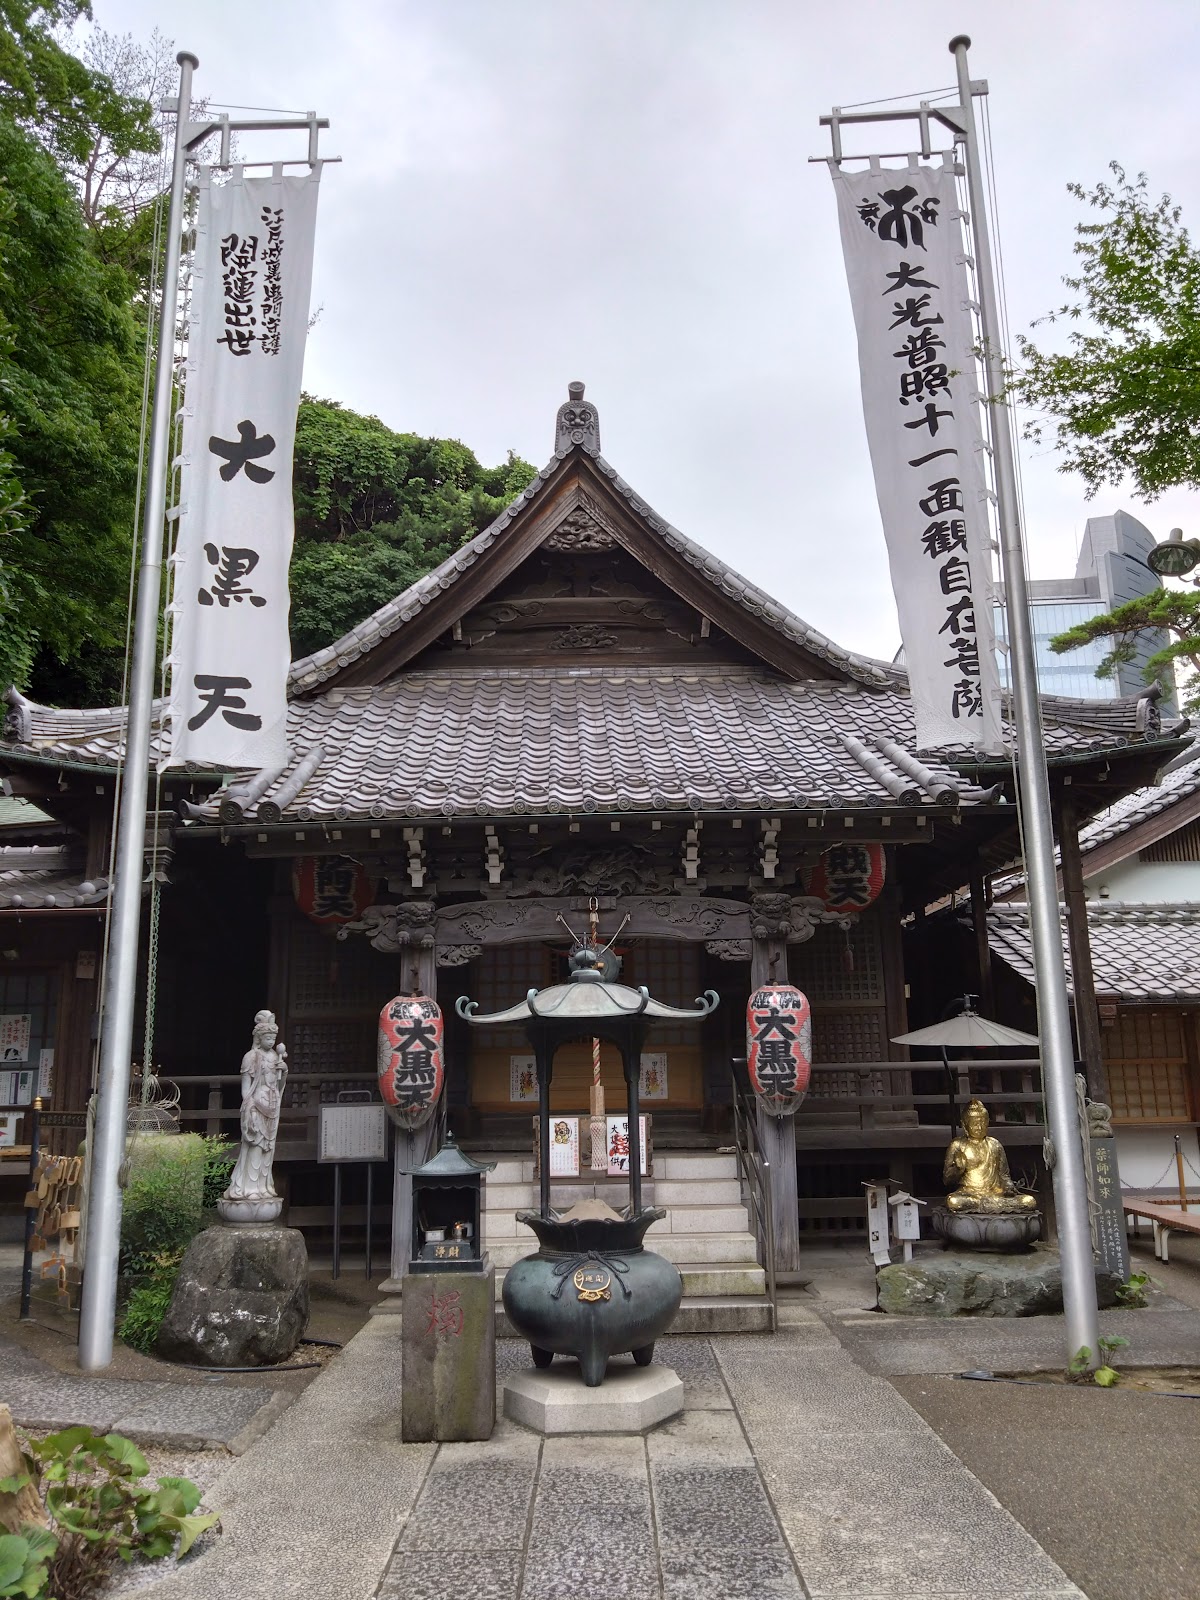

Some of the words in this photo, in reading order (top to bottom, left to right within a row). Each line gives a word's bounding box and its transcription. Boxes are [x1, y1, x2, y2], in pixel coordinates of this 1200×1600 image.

[216, 232, 259, 357] 開運出世
[259, 206, 285, 357] 江戸城裏鬼門守護
[187, 419, 277, 732] 大黒天
[392, 1016, 440, 1112] 大黒天
[752, 1006, 799, 1097] 大黒天
